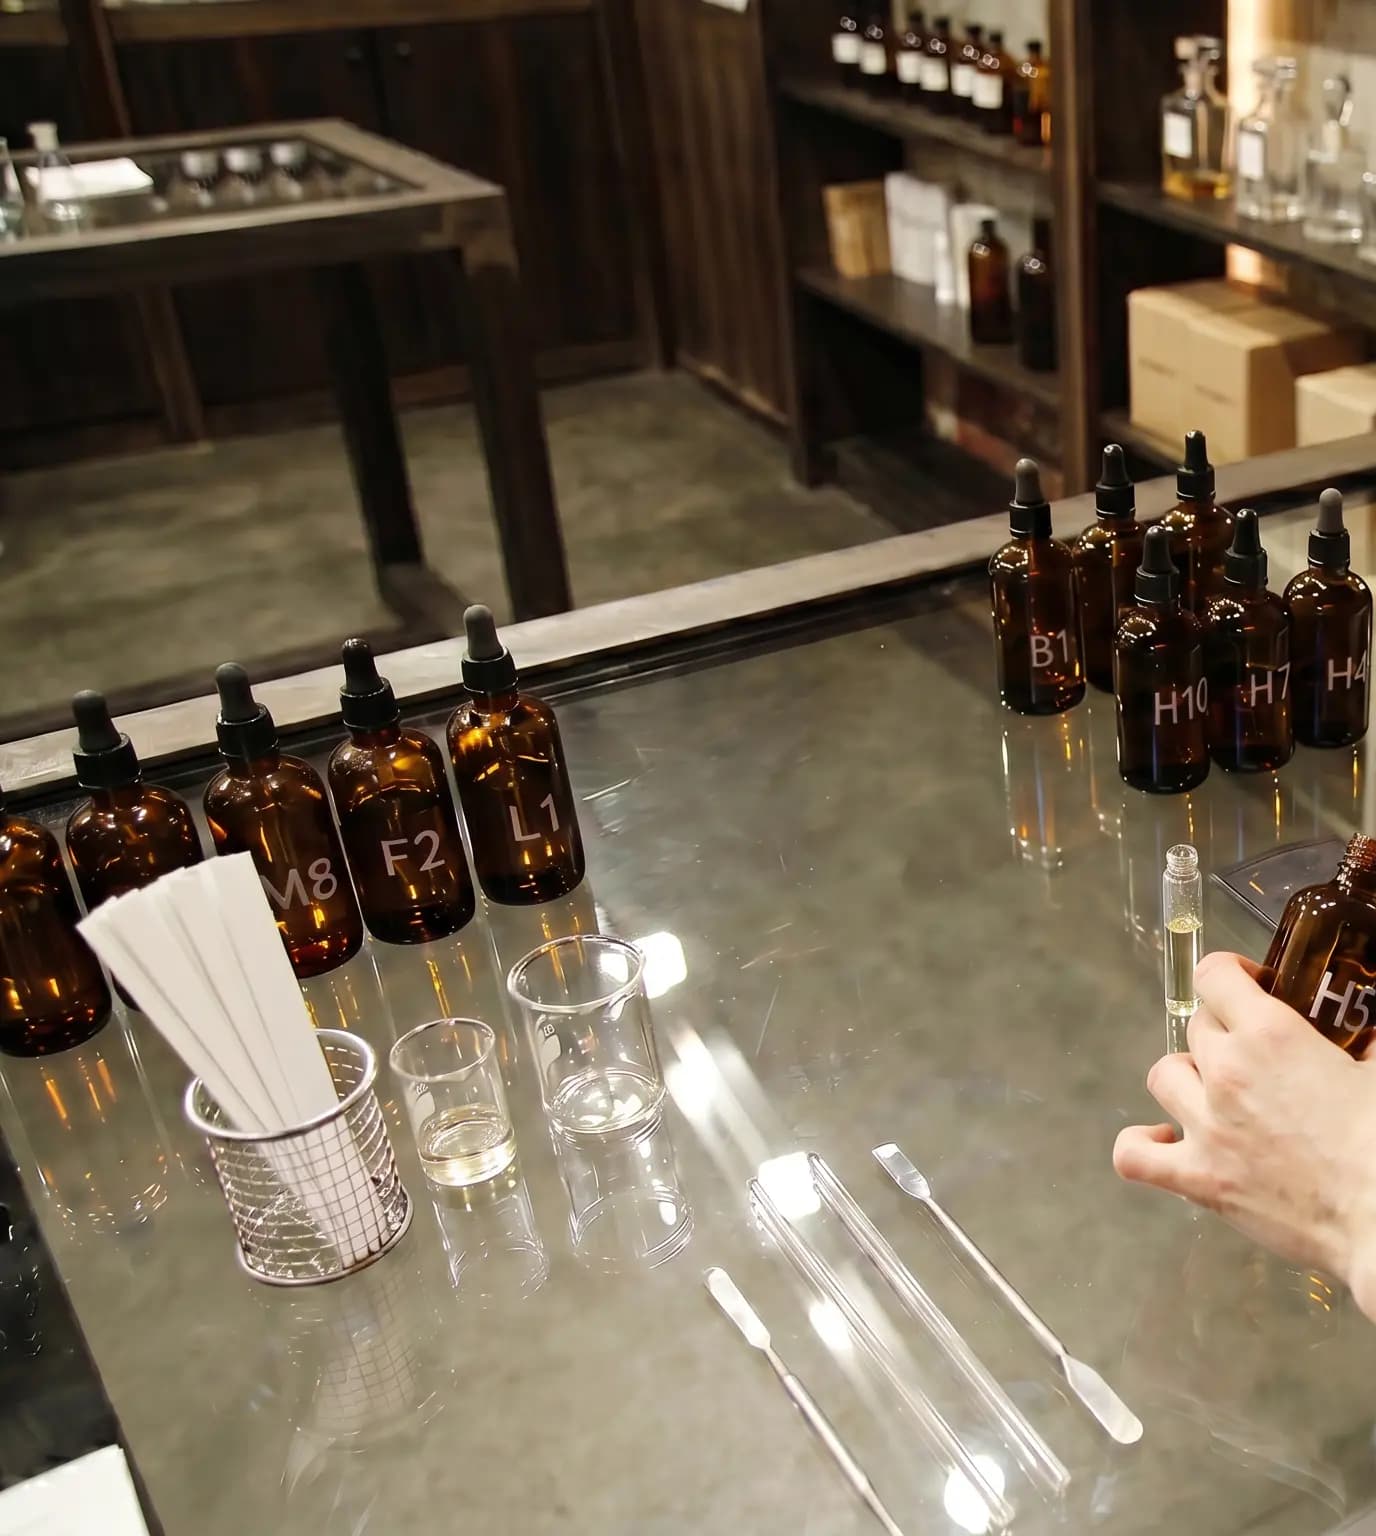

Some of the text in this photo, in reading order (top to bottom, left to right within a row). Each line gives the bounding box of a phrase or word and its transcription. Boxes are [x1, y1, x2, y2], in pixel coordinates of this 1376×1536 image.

[1030, 629, 1070, 669] B1
[1327, 650, 1369, 691] H4
[1154, 676, 1208, 725] H10
[1250, 662, 1291, 707] H7
[508, 793, 560, 842] L1
[381, 830, 446, 877] F2
[259, 857, 338, 910] M8
[1308, 970, 1376, 1032] H5
